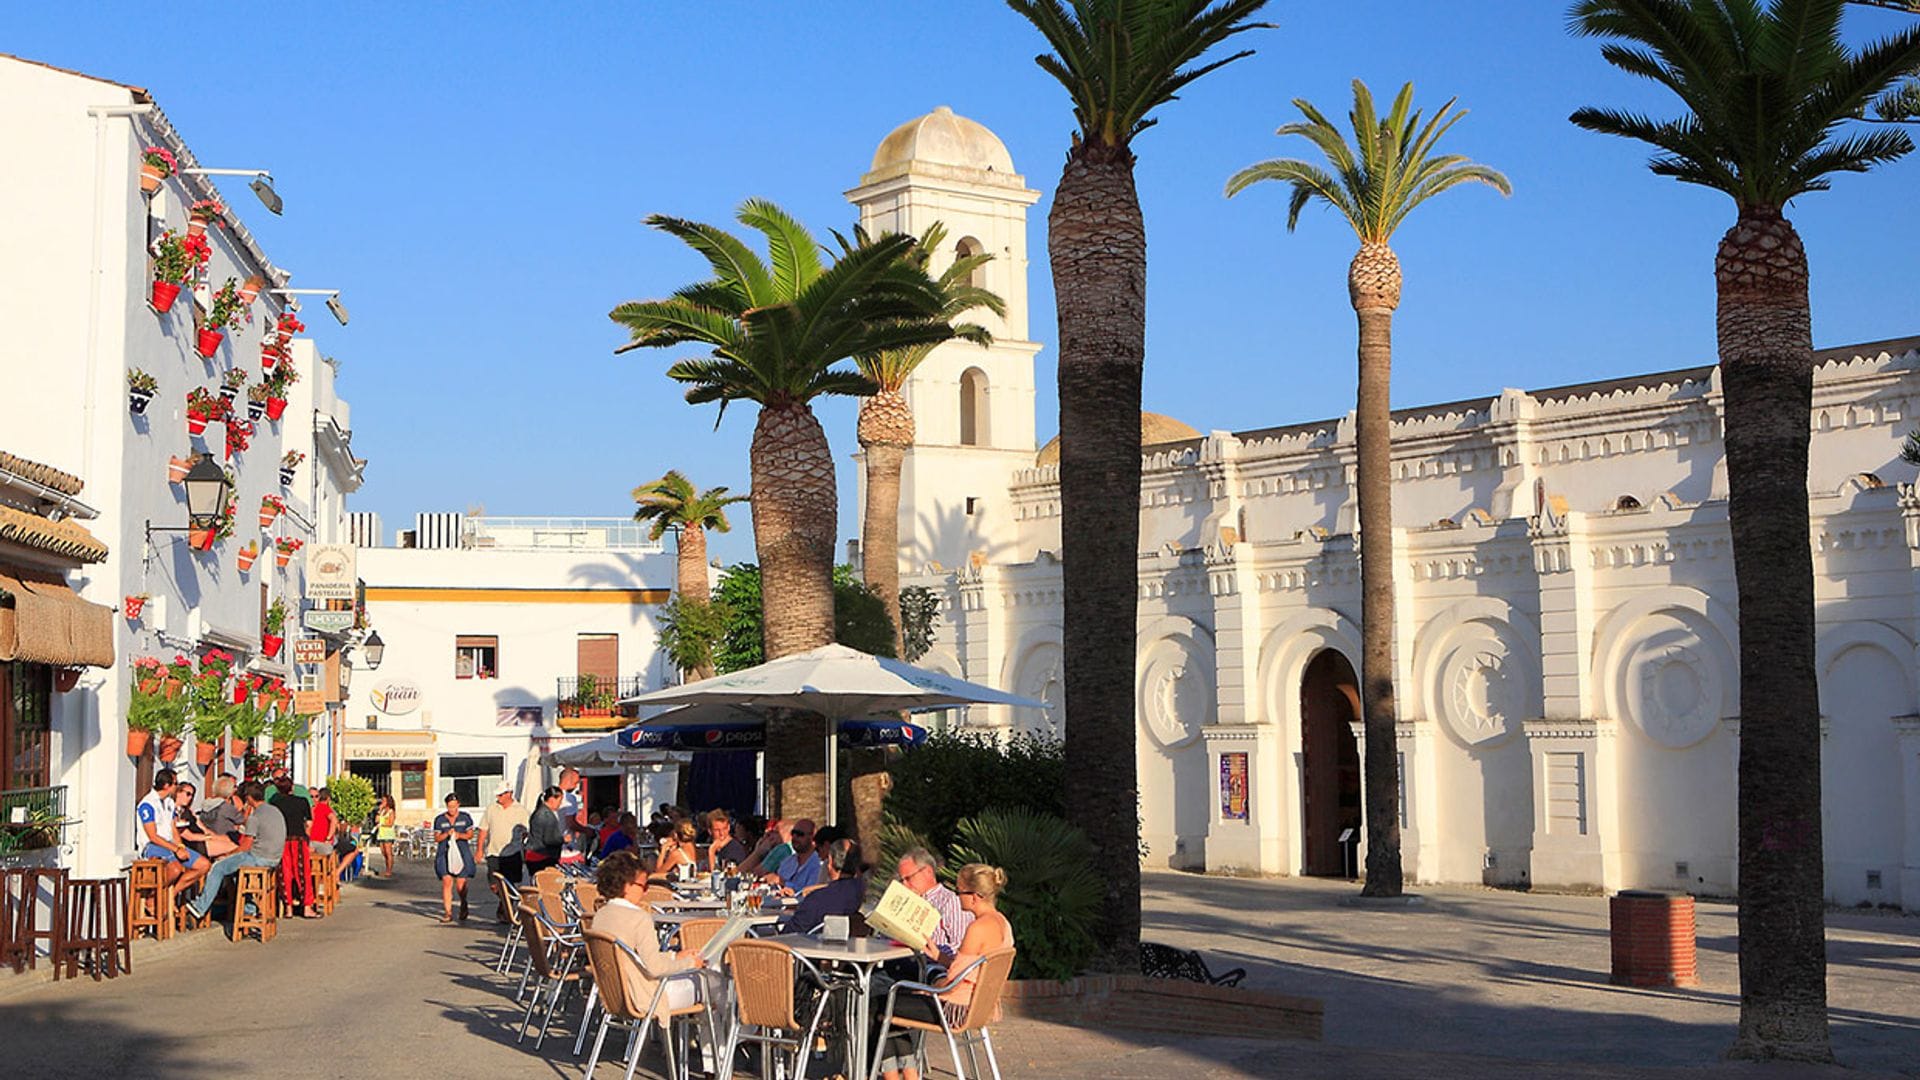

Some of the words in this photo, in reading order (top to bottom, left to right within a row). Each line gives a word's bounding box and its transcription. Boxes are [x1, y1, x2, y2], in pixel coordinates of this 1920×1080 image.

[297, 642, 322, 651] VENTA
[308, 653, 325, 662] PAN
[726, 730, 762, 744] pepsi
